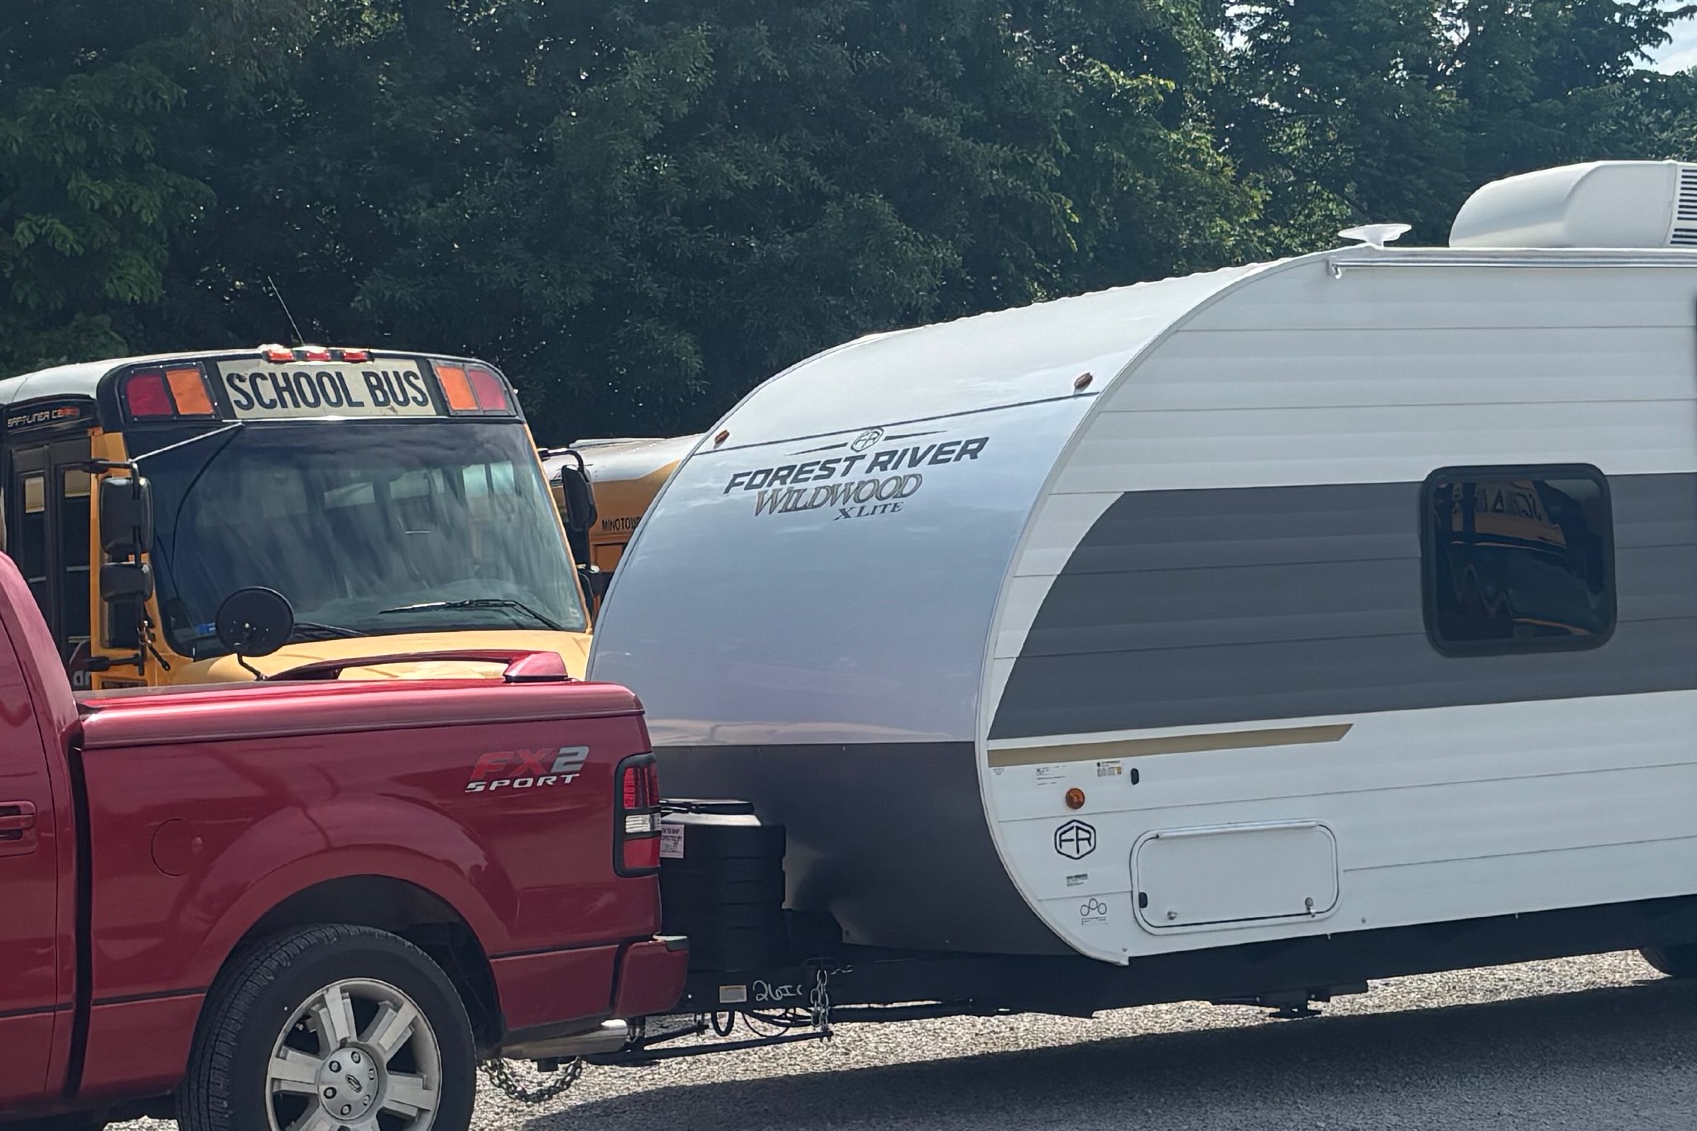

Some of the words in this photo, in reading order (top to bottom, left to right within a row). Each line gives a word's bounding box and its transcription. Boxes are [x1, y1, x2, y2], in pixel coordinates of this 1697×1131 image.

[226, 370, 365, 411] SCHOOL
[361, 370, 430, 407] BUS
[723, 454, 866, 495] FOREST
[865, 436, 990, 475] RIVER
[755, 473, 923, 517] WILDWOOD
[464, 773, 580, 793] SPORT
[469, 745, 590, 781] FX2
